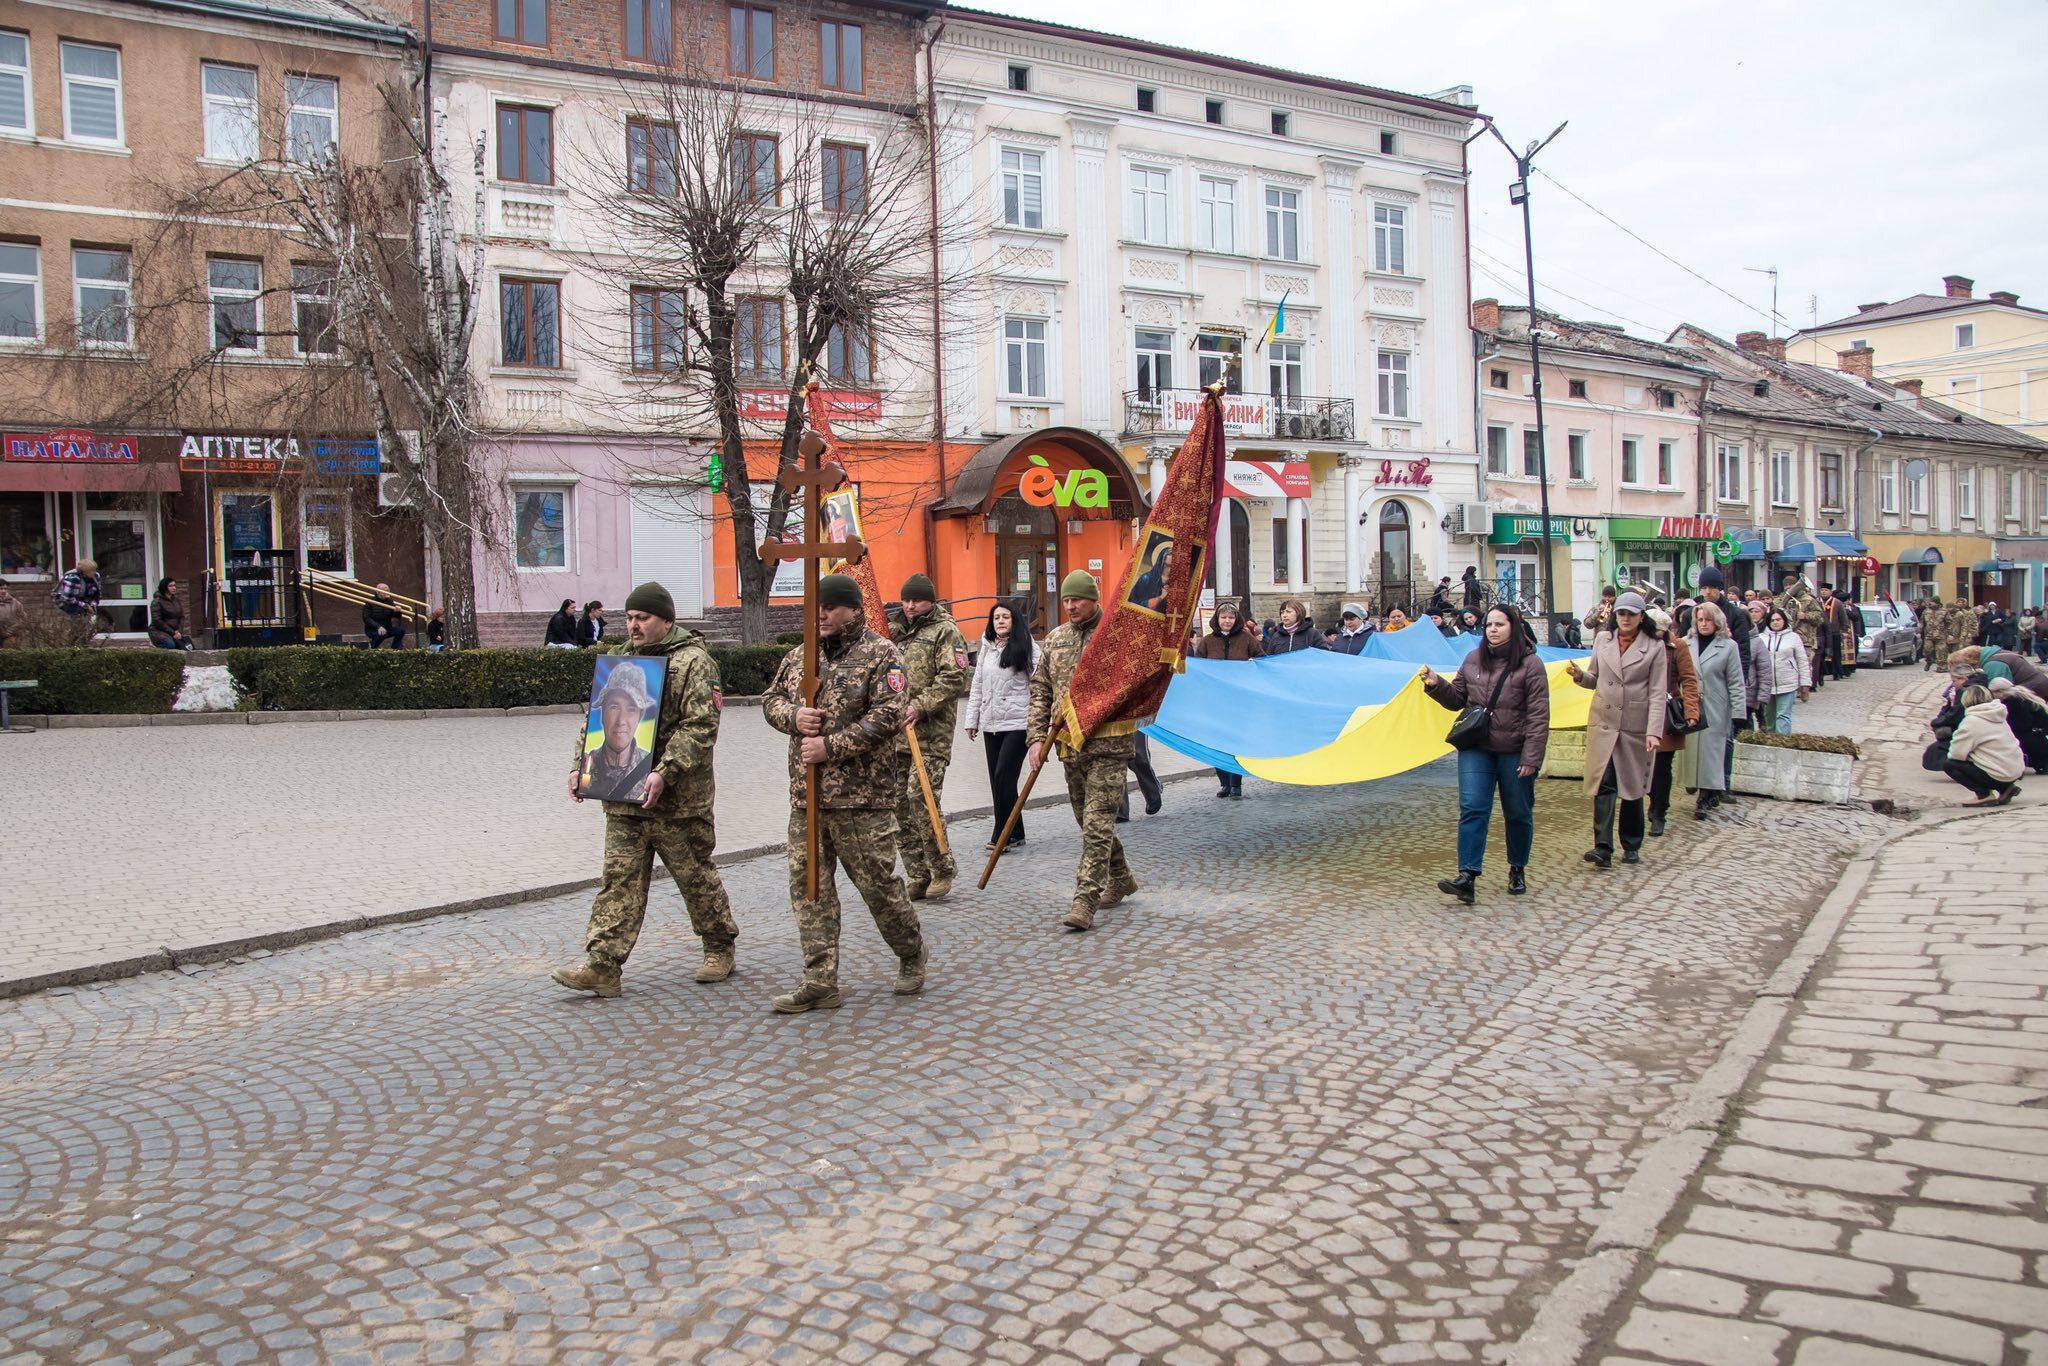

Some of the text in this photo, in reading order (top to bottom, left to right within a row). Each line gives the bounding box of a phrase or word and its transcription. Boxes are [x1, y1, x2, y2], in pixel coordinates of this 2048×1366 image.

[1174, 401, 1264, 425] ВИВАНКА
[11, 440, 134, 459] НАТАЛКА
[180, 435, 304, 460] АПТЕКА
[1513, 519, 1571, 535] ШКОЛРИК
[1659, 516, 1723, 539] АПТЕКА
[1625, 542, 1679, 551] ЗДОРОВА РОДИНА
